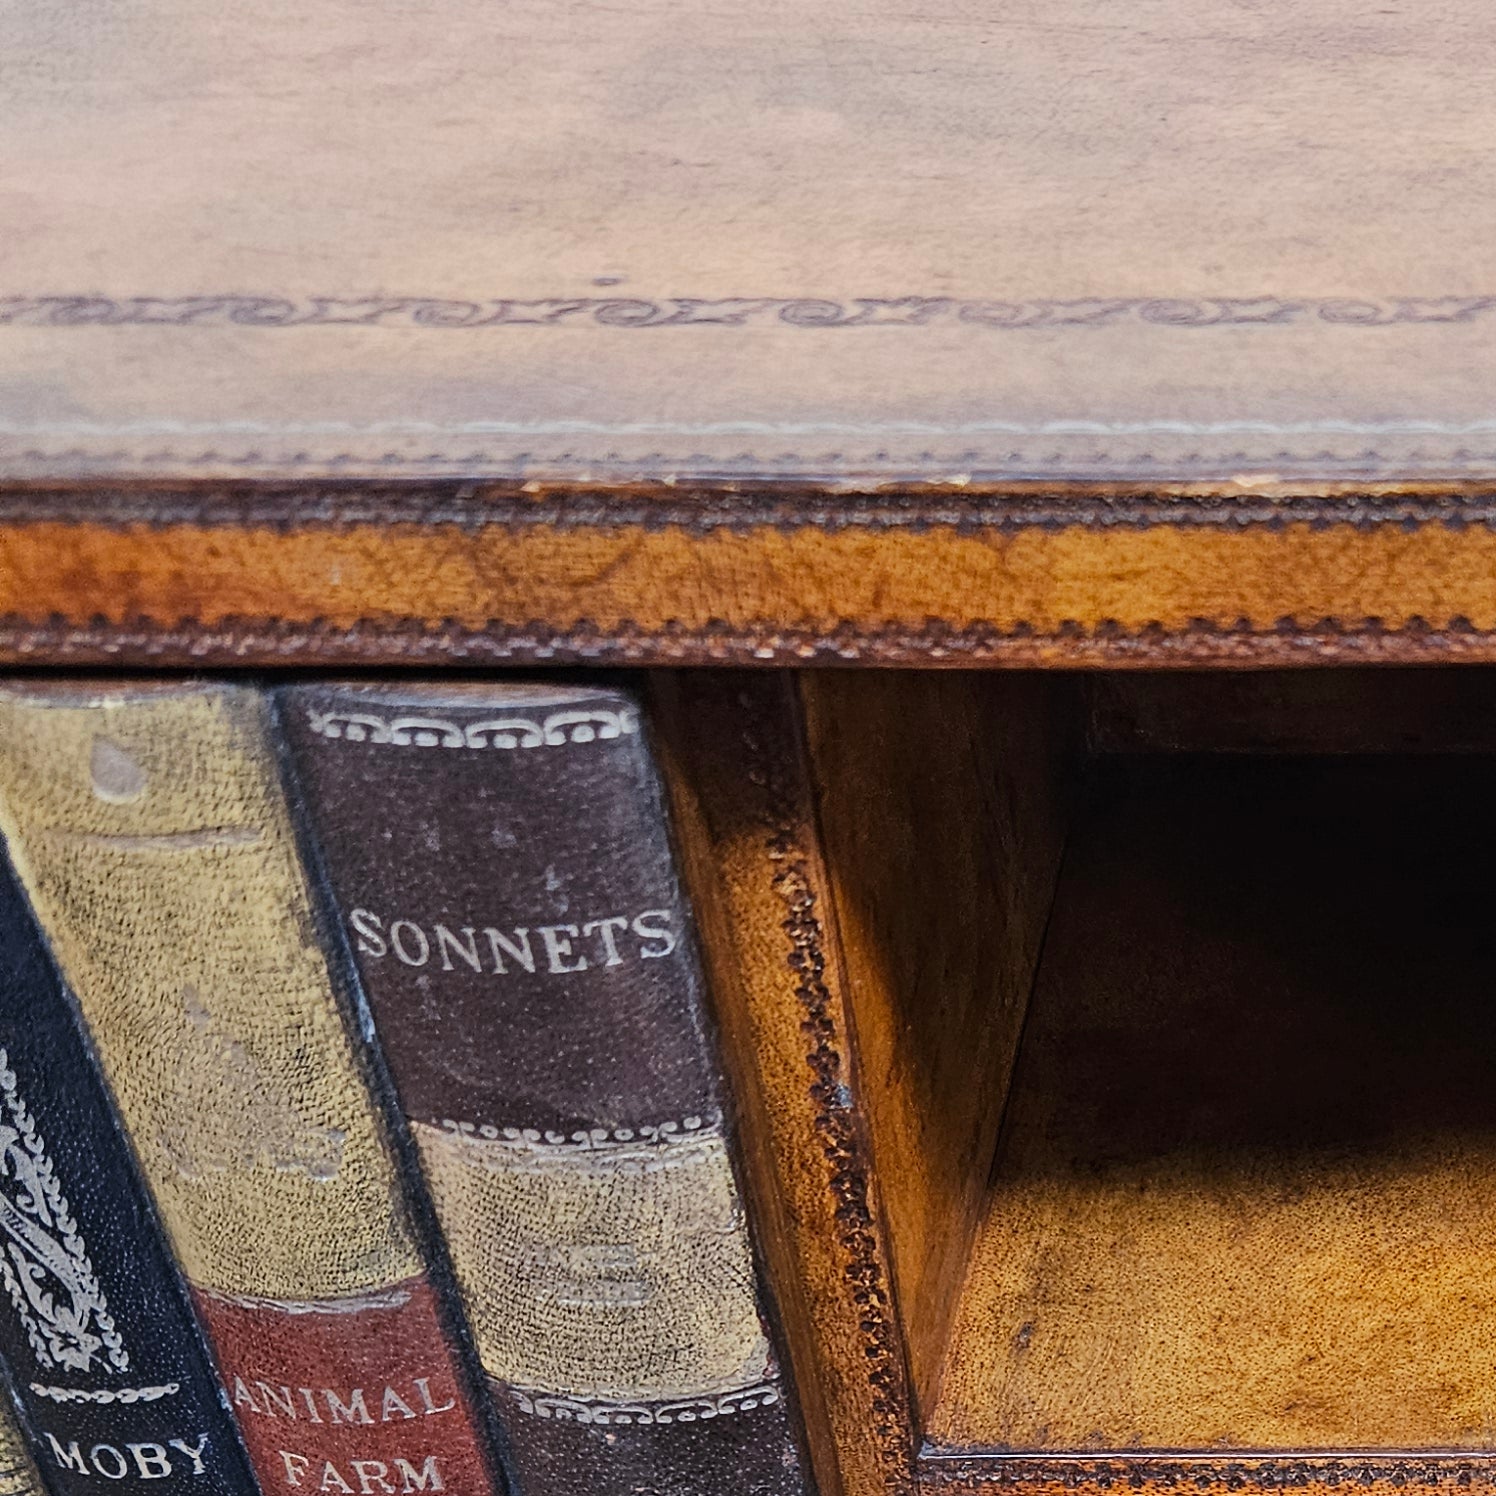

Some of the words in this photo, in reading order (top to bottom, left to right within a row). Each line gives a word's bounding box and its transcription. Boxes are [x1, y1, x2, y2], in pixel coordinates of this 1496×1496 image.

[350, 908, 676, 974] SONNETS
[234, 1374, 456, 1424] ANIMAL
[43, 1431, 209, 1480] MOBY
[279, 1450, 445, 1495] FARM
